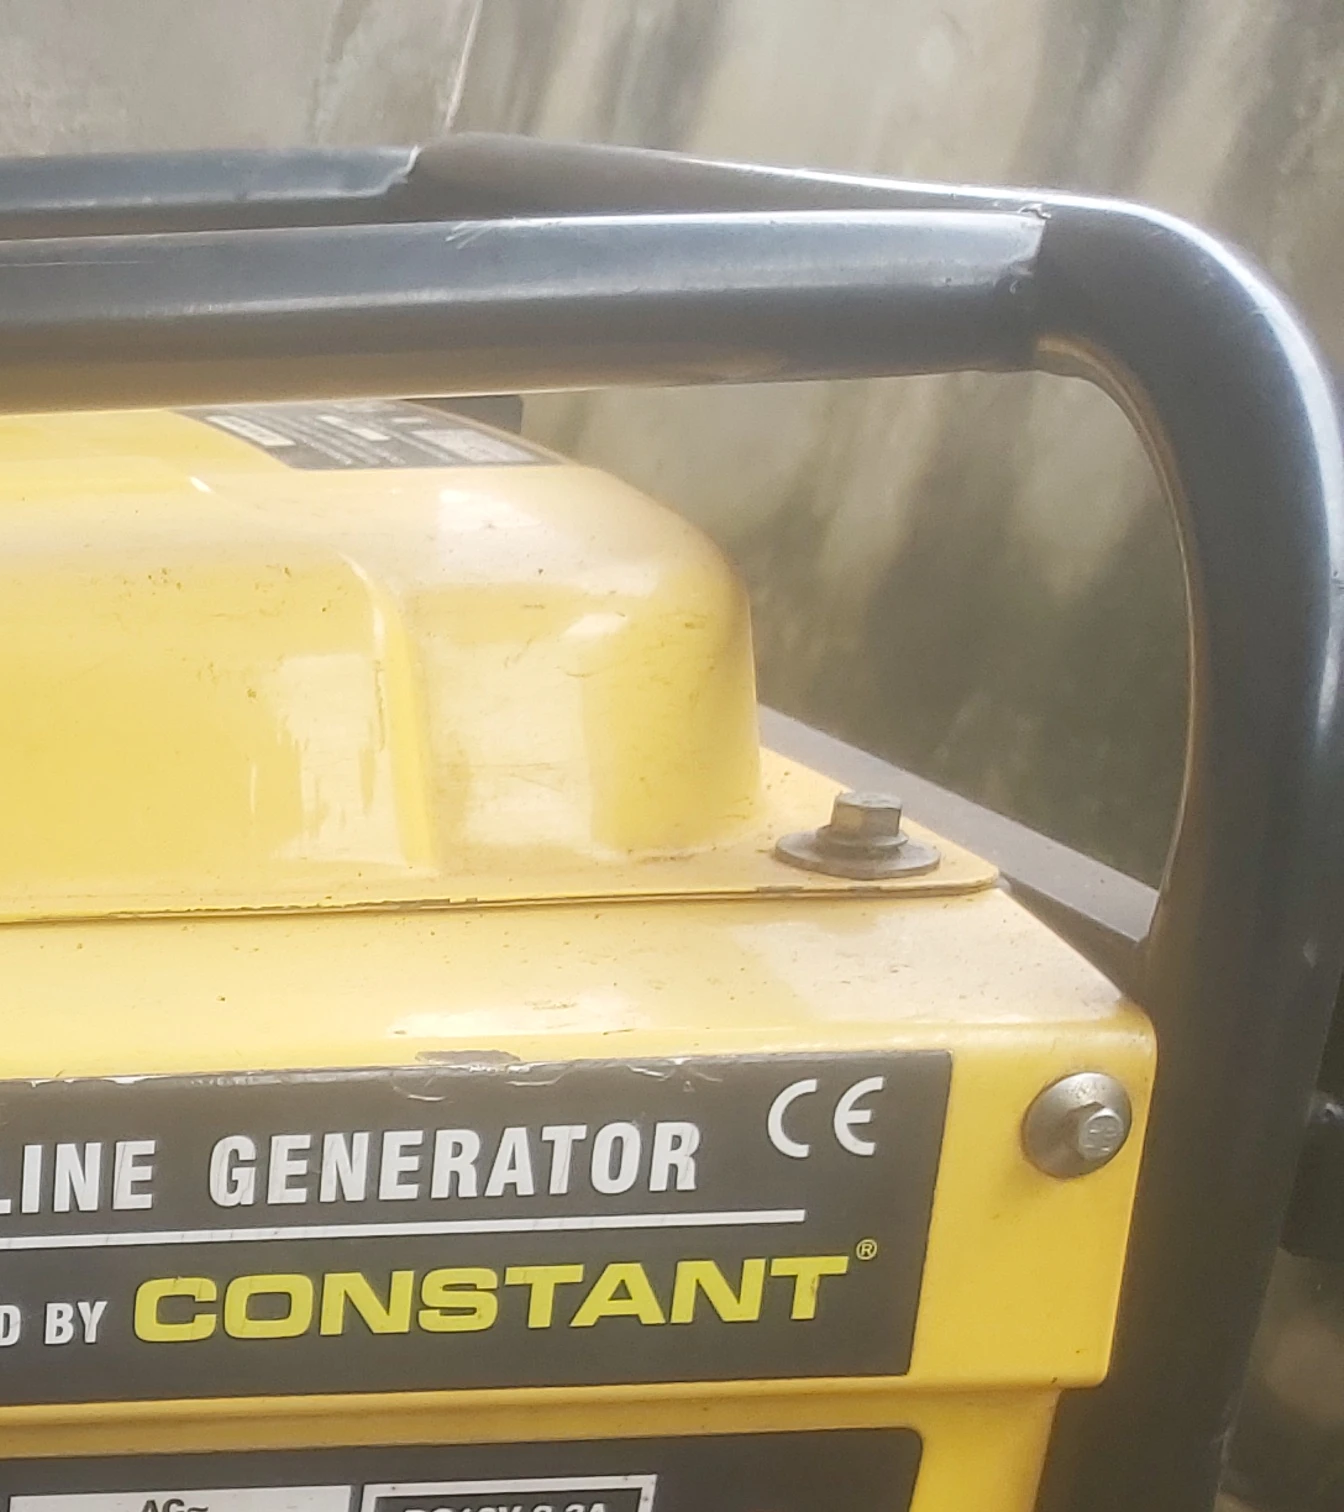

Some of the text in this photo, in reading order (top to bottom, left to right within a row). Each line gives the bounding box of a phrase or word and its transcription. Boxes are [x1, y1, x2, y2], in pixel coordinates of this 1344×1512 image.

[209, 1120, 701, 1207] GENERATOR
[43, 1300, 108, 1346] BY
[133, 1255, 849, 1343] CONSTANT
